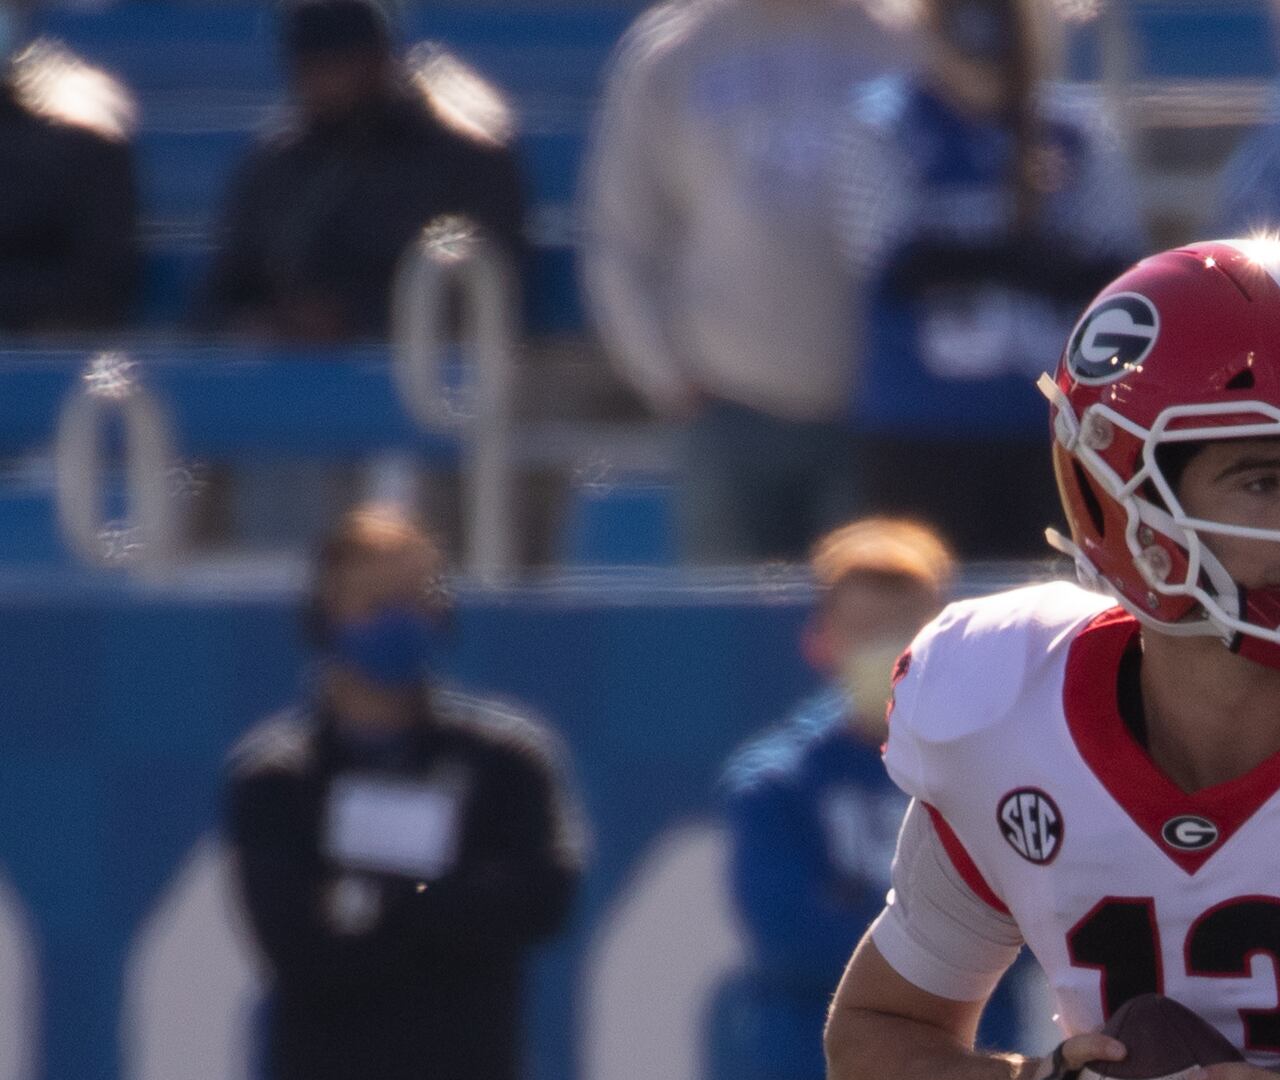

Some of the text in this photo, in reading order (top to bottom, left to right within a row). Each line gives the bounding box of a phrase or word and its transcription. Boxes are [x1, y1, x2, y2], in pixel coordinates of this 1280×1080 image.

[1066, 291, 1159, 386] G
[999, 791, 1059, 862] SEC
[1162, 815, 1218, 850] G
